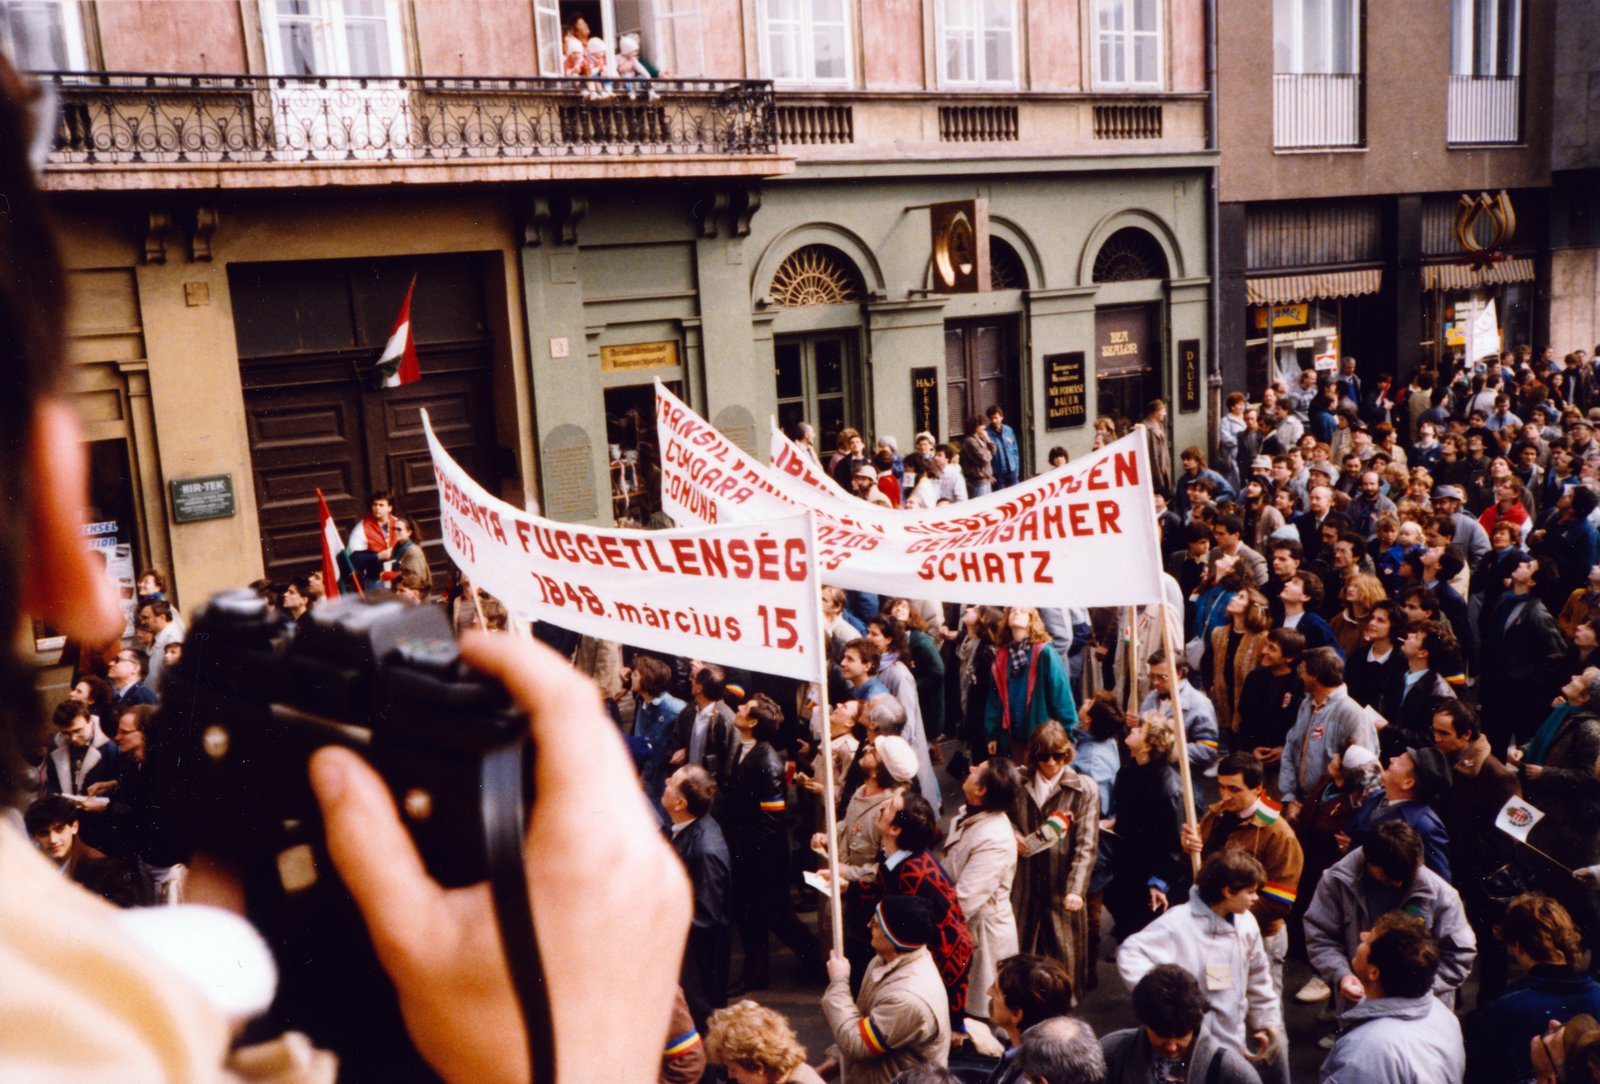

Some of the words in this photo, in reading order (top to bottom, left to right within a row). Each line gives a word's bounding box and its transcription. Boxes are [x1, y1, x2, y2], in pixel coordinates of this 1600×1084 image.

[1186, 351, 1195, 400] DAUER
[905, 499, 1123, 554] GEMEINSAMER
[917, 550, 1054, 584] SCHATZ
[756, 604, 804, 653] 15.
